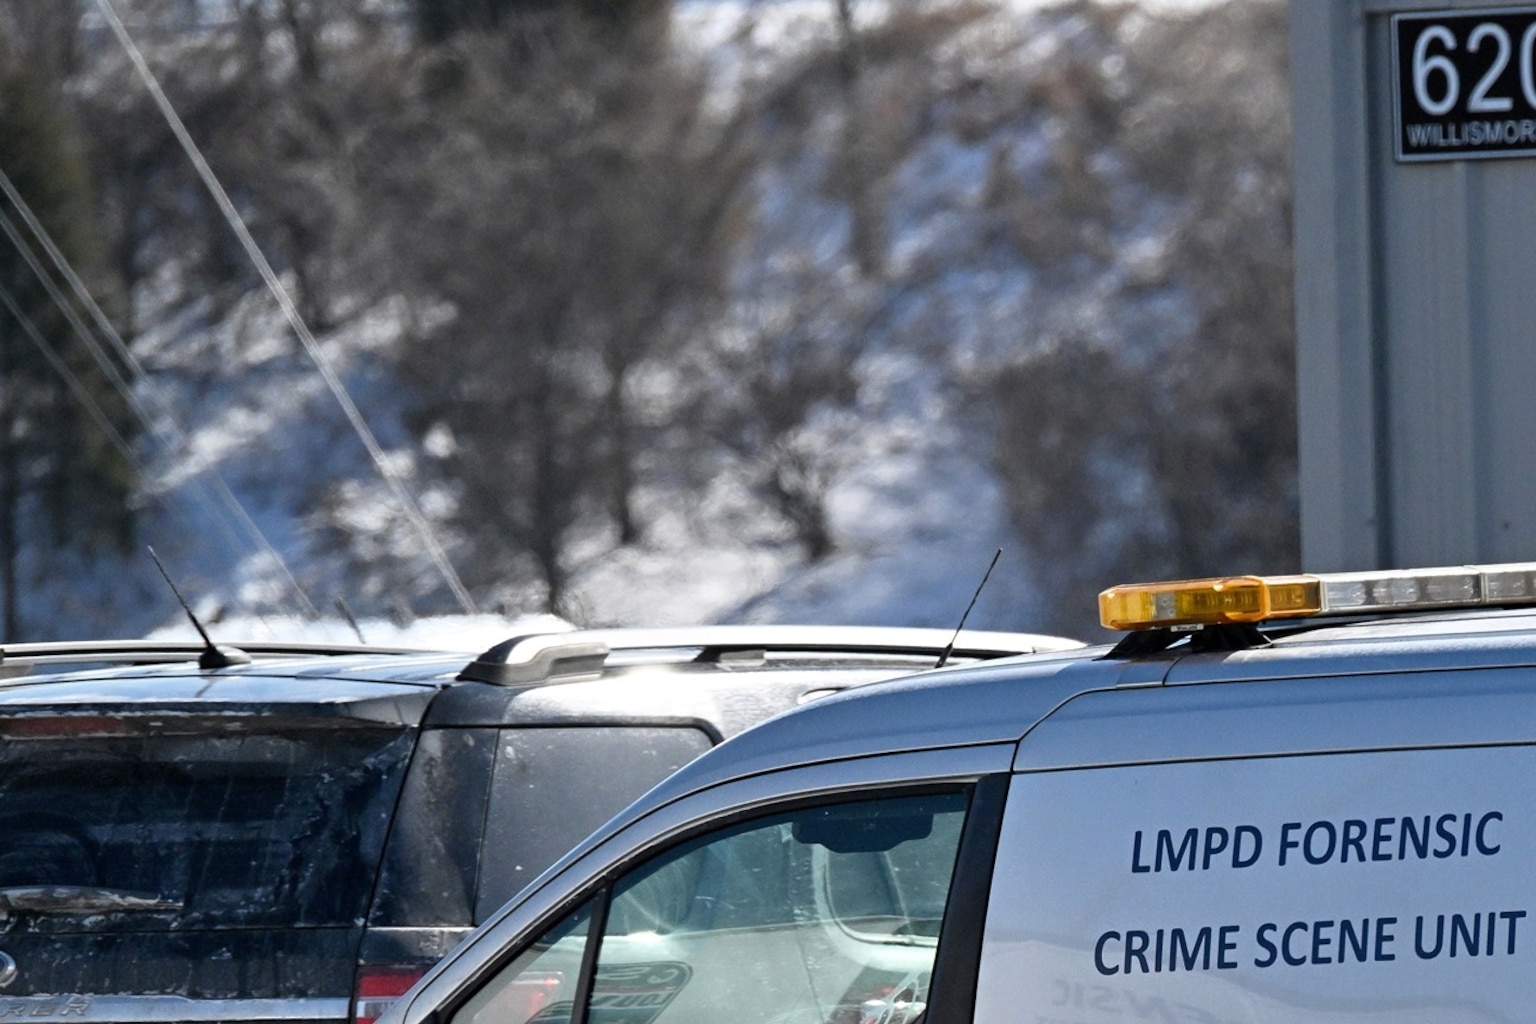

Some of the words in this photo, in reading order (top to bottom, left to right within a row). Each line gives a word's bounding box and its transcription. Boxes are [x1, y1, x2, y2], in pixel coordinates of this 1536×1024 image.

[1131, 825, 1263, 873] LMPD
[1278, 811, 1503, 866] FORENSIC
[1094, 925, 1240, 976] CRIME
[1253, 917, 1398, 968] SCENE
[1414, 910, 1527, 960] UNIT
